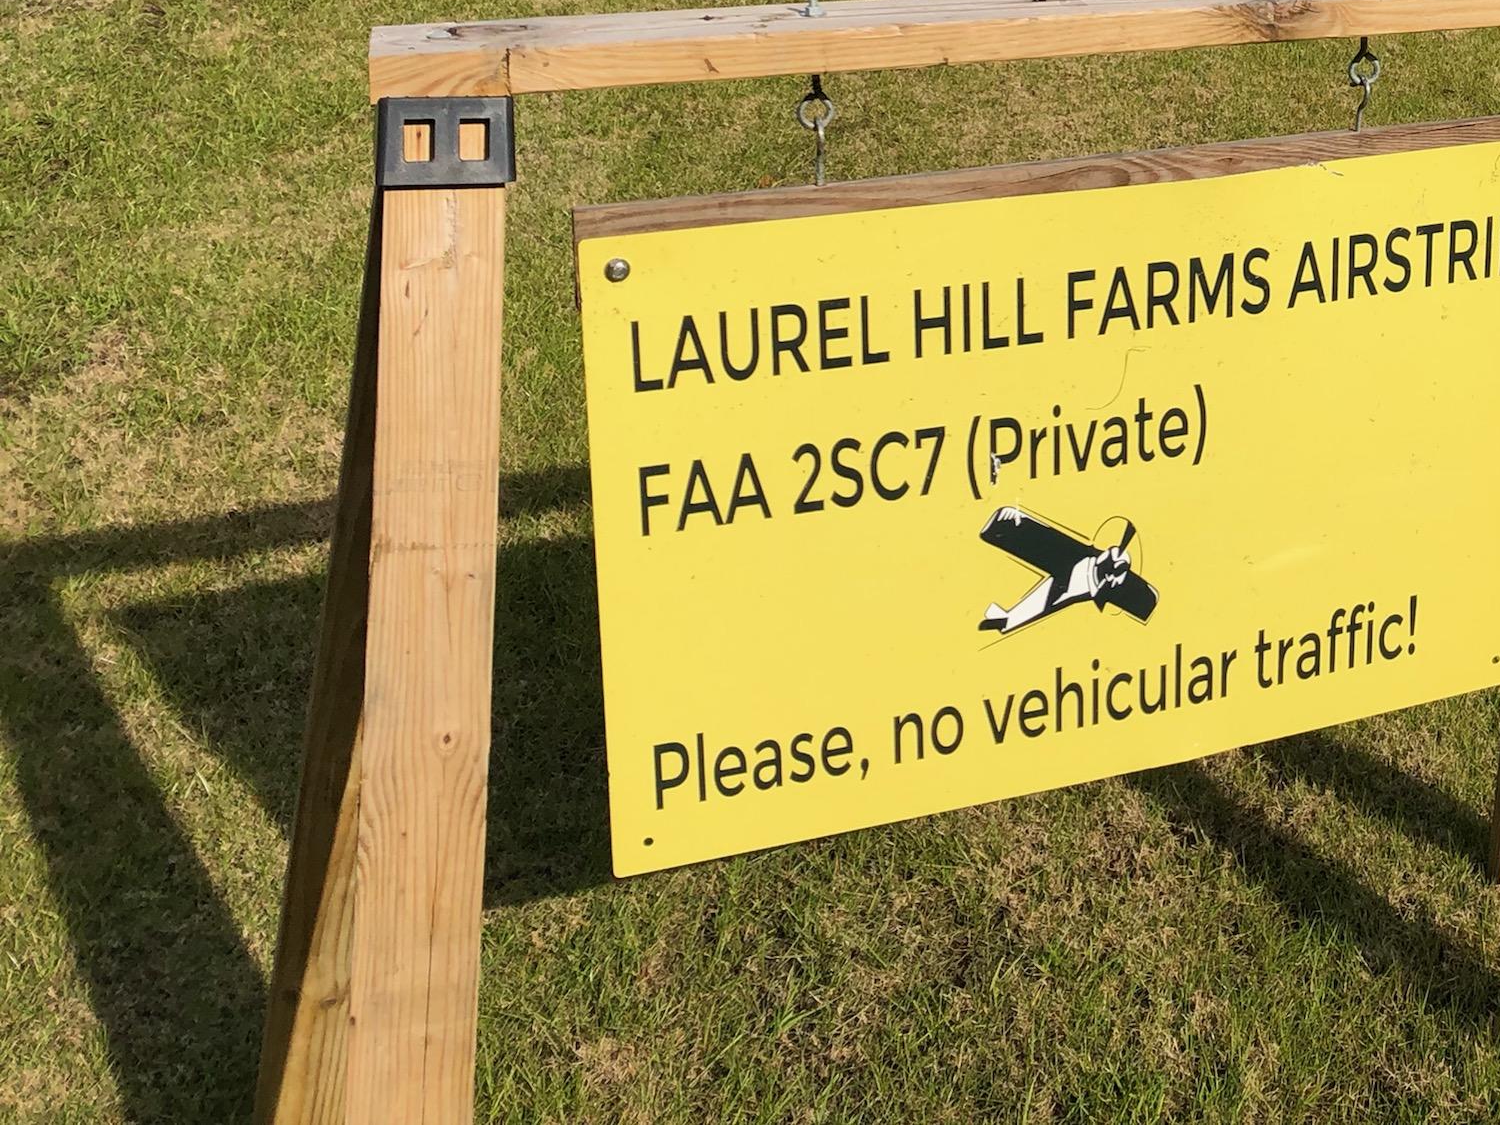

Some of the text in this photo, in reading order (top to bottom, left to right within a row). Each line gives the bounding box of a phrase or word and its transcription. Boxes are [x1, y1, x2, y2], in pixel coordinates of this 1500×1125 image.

[631, 295, 890, 393] LAUREL
[914, 277, 1044, 359] HILL
[1067, 247, 1270, 340] FARMS
[639, 384, 1207, 536] FAA 2SC7 (Private)
[654, 595, 1417, 810] Please, no vehicular traffic!
